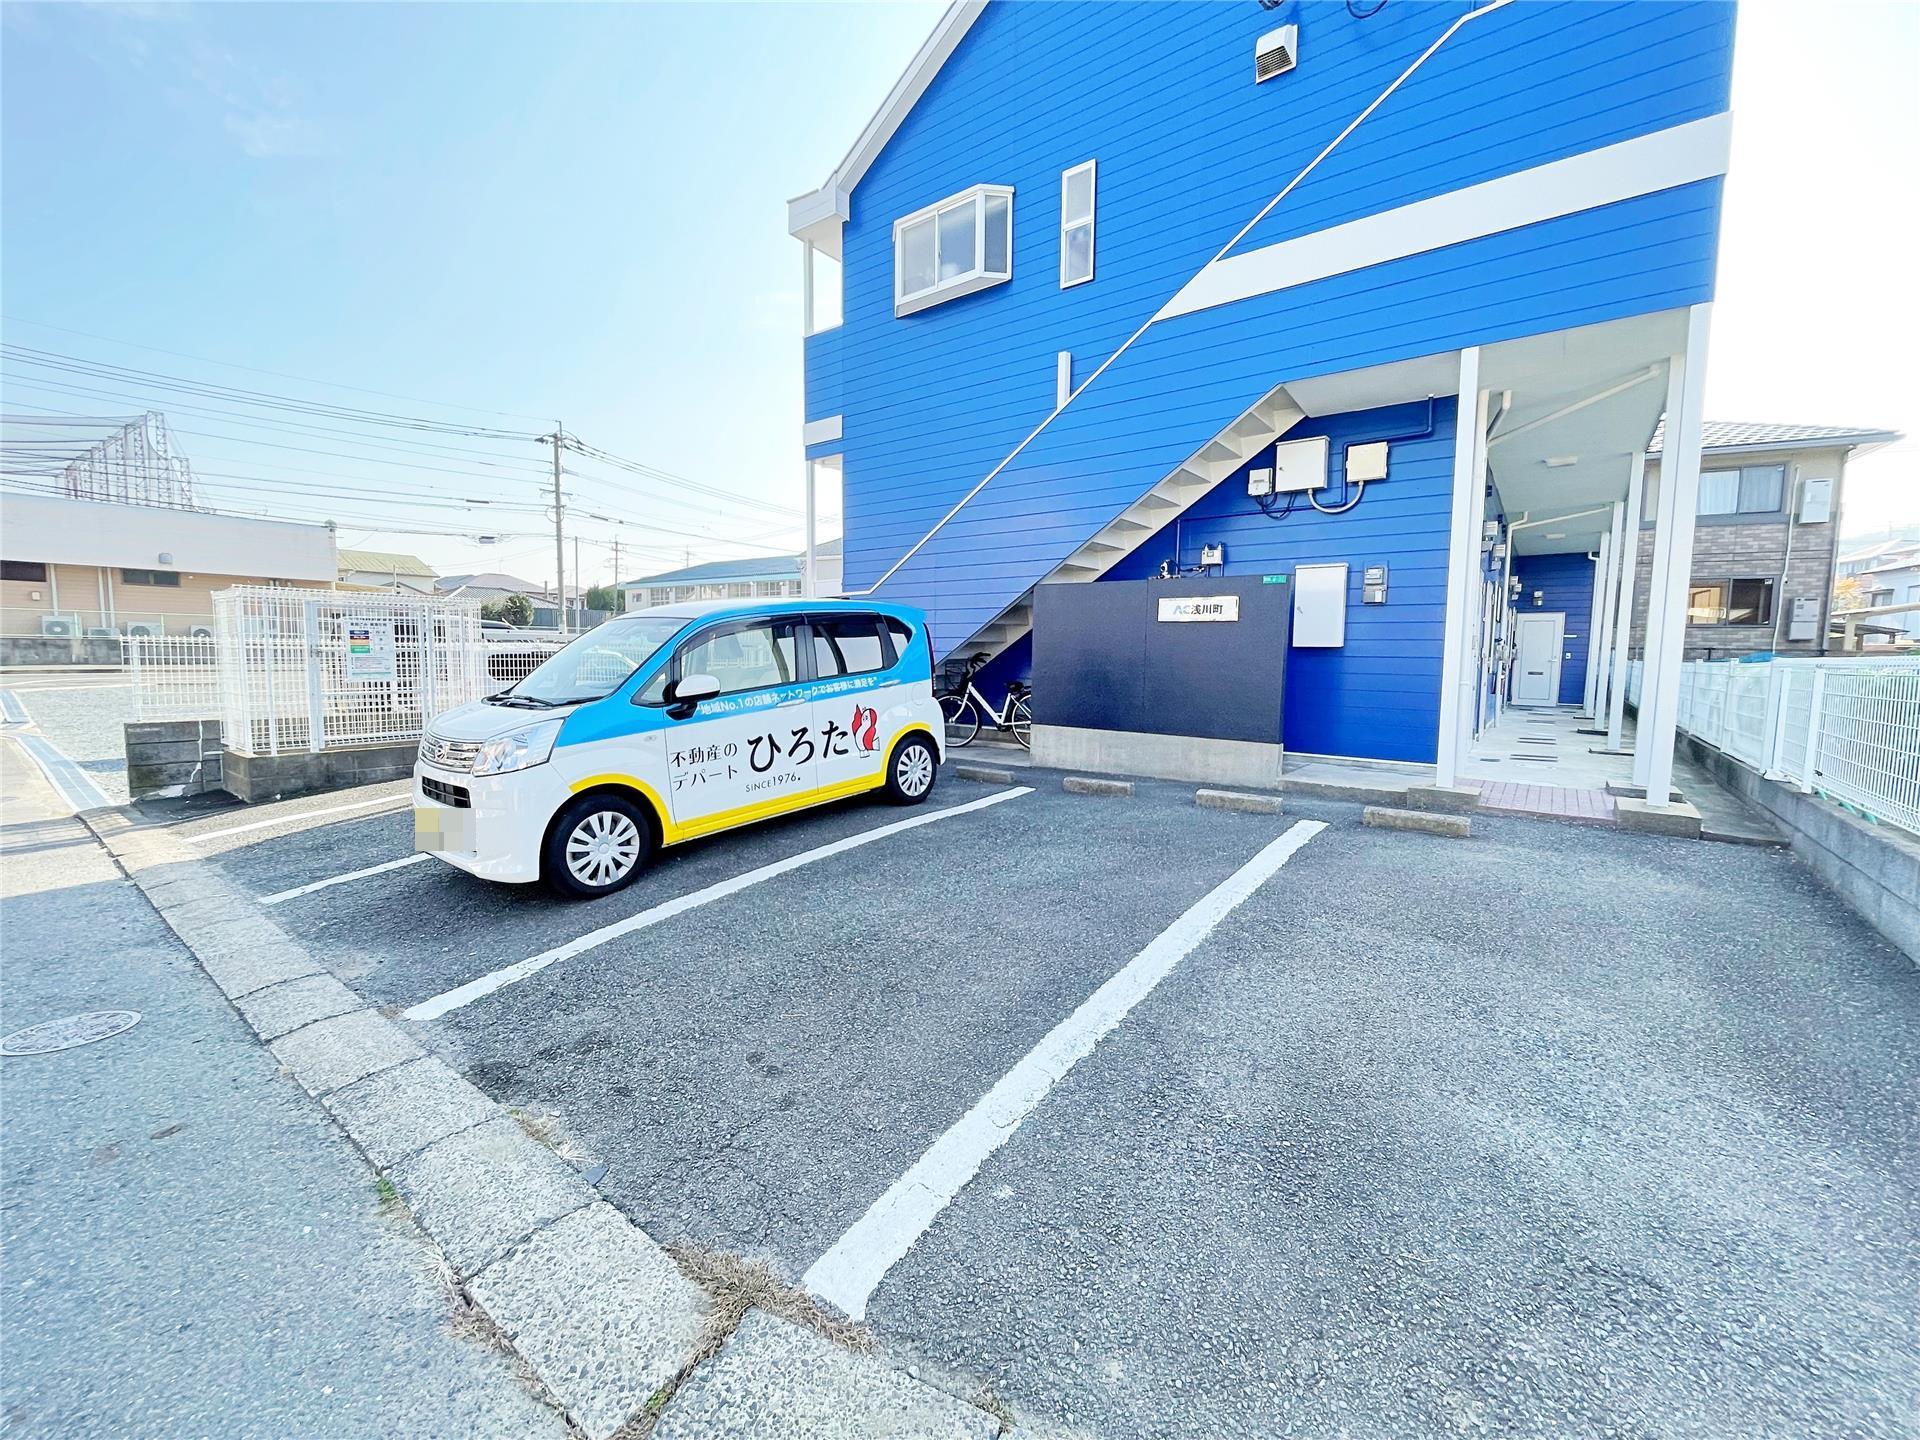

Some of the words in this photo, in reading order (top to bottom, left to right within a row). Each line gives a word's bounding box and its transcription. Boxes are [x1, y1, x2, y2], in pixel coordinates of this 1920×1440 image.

[670, 742, 738, 767] 不動産の
[747, 720, 848, 773] ひろた
[673, 764, 738, 791] デパート
